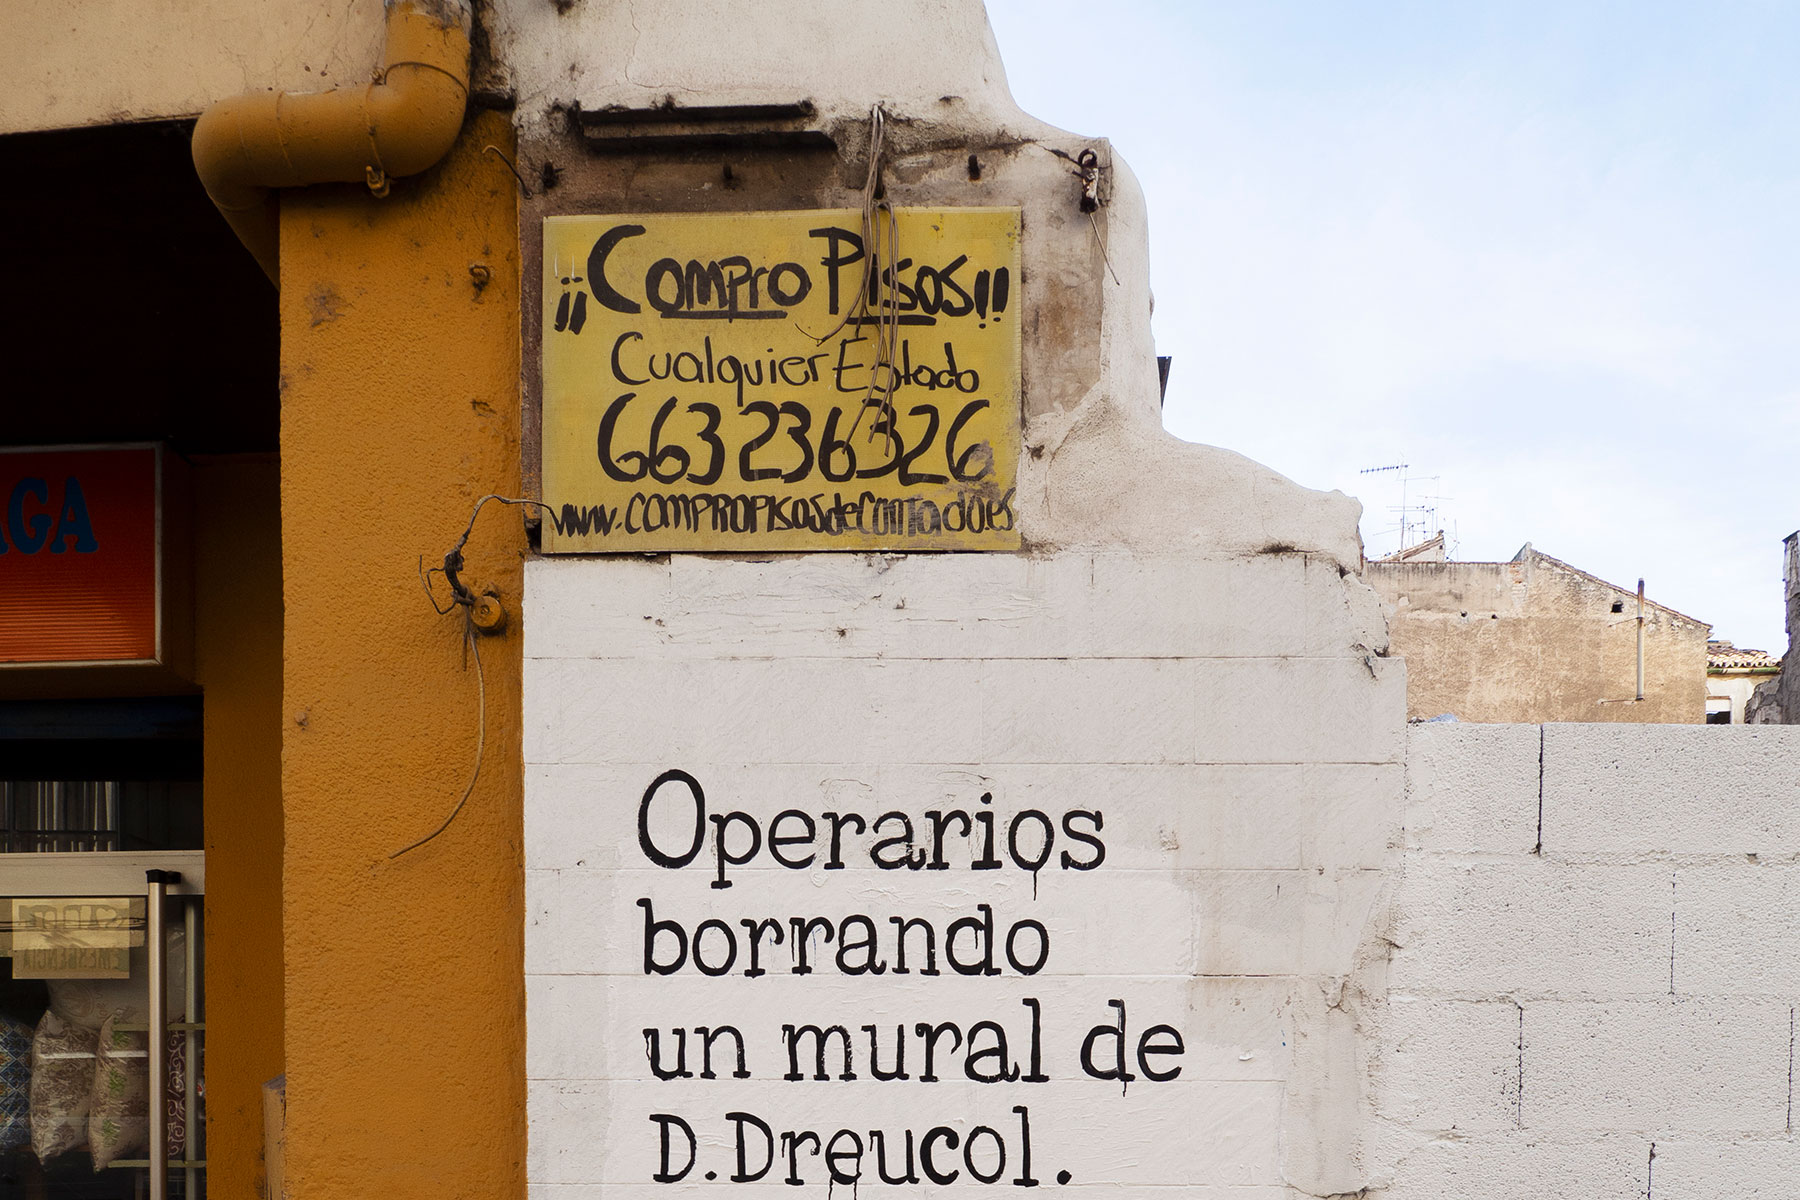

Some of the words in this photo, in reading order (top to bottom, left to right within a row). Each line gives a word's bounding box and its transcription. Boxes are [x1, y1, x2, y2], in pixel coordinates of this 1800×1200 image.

[610, 331, 830, 407] Cualquier
[832, 336, 980, 393] Estado
[0, 476, 98, 555] GA
[637, 769, 1106, 889] Operarios
[637, 898, 1050, 978] borrando
[643, 1025, 751, 1081] un
[781, 997, 1050, 1083] mural
[1080, 999, 1185, 1084] de
